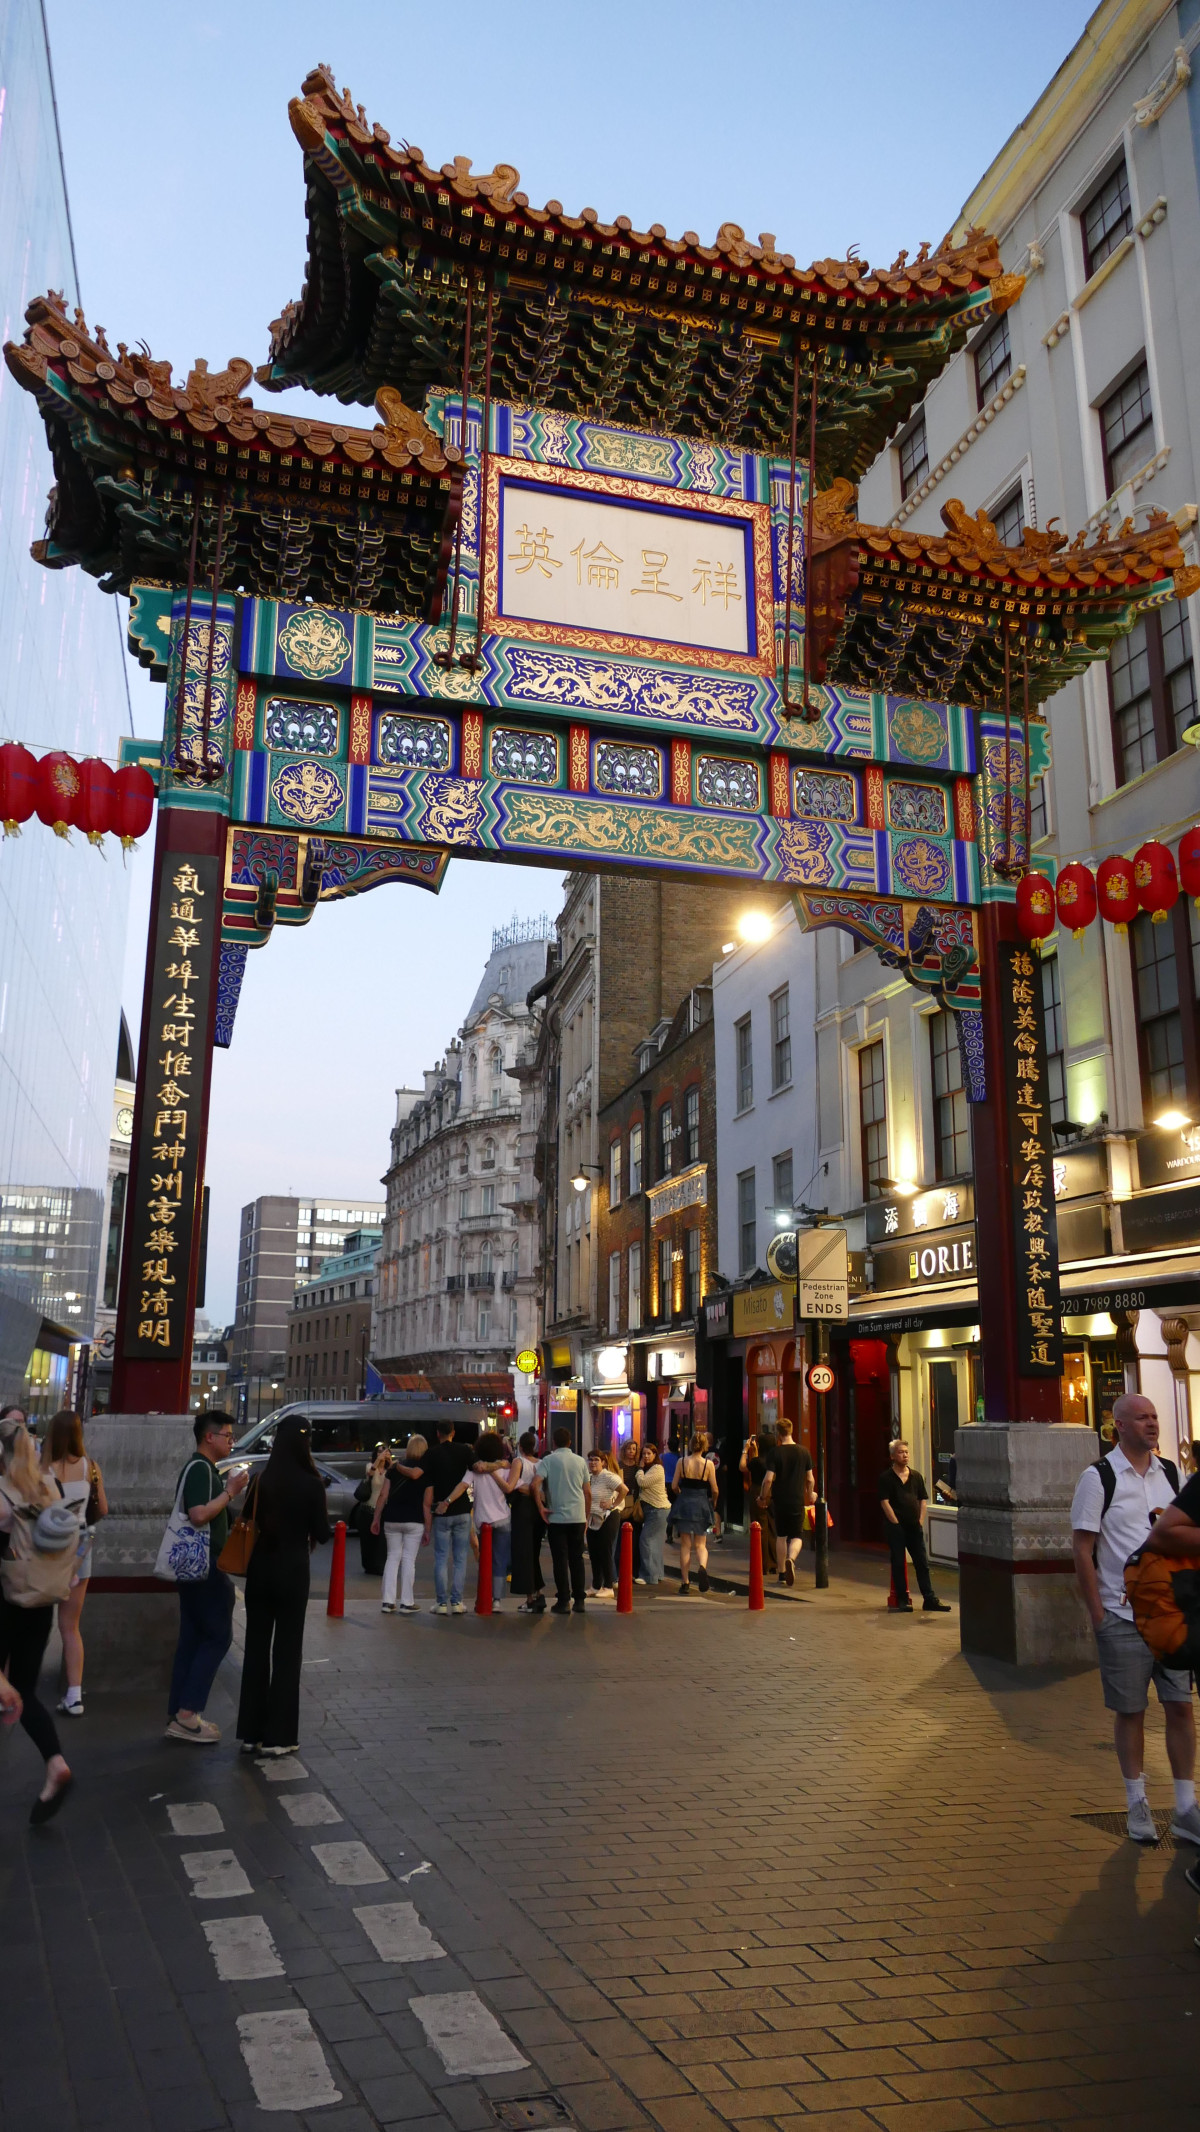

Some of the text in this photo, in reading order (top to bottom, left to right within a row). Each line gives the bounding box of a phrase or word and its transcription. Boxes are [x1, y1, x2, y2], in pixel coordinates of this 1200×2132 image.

[507, 523, 742, 611] 英倫呈祥
[920, 1240, 977, 1277] ORIE
[802, 1282, 845, 1291] Pedestrian
[814, 1292, 834, 1300] Zone
[1084, 1295, 1110, 1312] 7989
[1115, 1291, 1145, 1309] 8880
[806, 1303, 843, 1314] ENDS
[858, 1323, 869, 1333] Dim
[870, 1322, 882, 1332] Sum
[883, 1319, 902, 1330] served
[812, 1373, 831, 1384] 20
